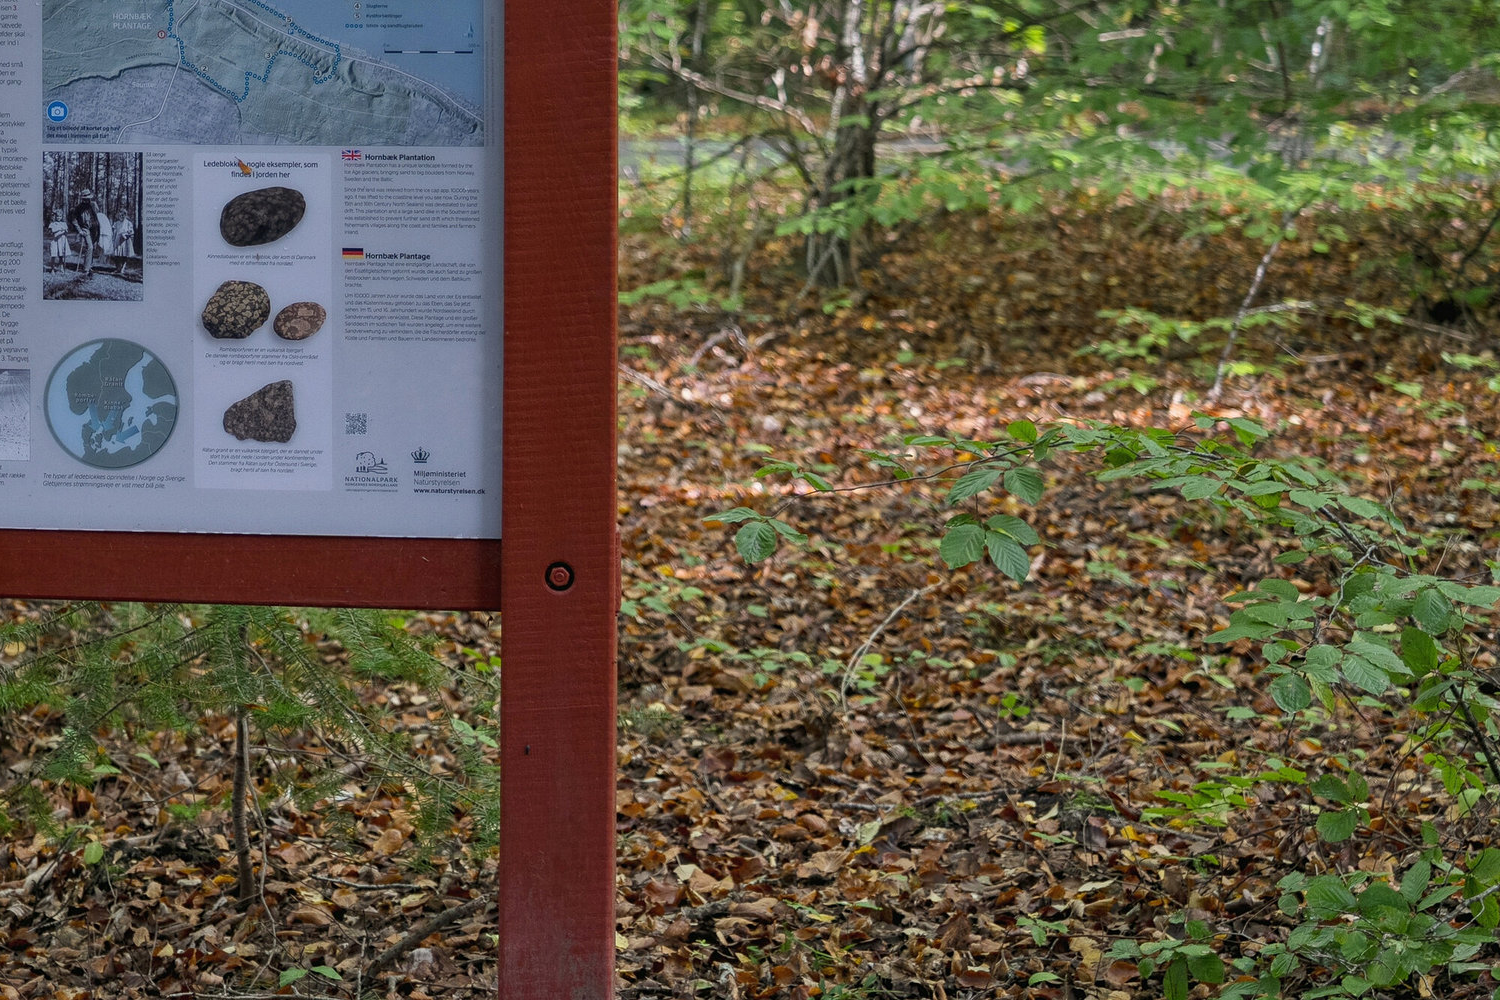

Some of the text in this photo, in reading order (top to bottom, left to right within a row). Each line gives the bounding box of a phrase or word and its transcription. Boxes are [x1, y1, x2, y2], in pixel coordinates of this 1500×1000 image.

[247, 161, 266, 169] nogle
[266, 161, 303, 169] eksempler,
[256, 171, 278, 179] jorden
